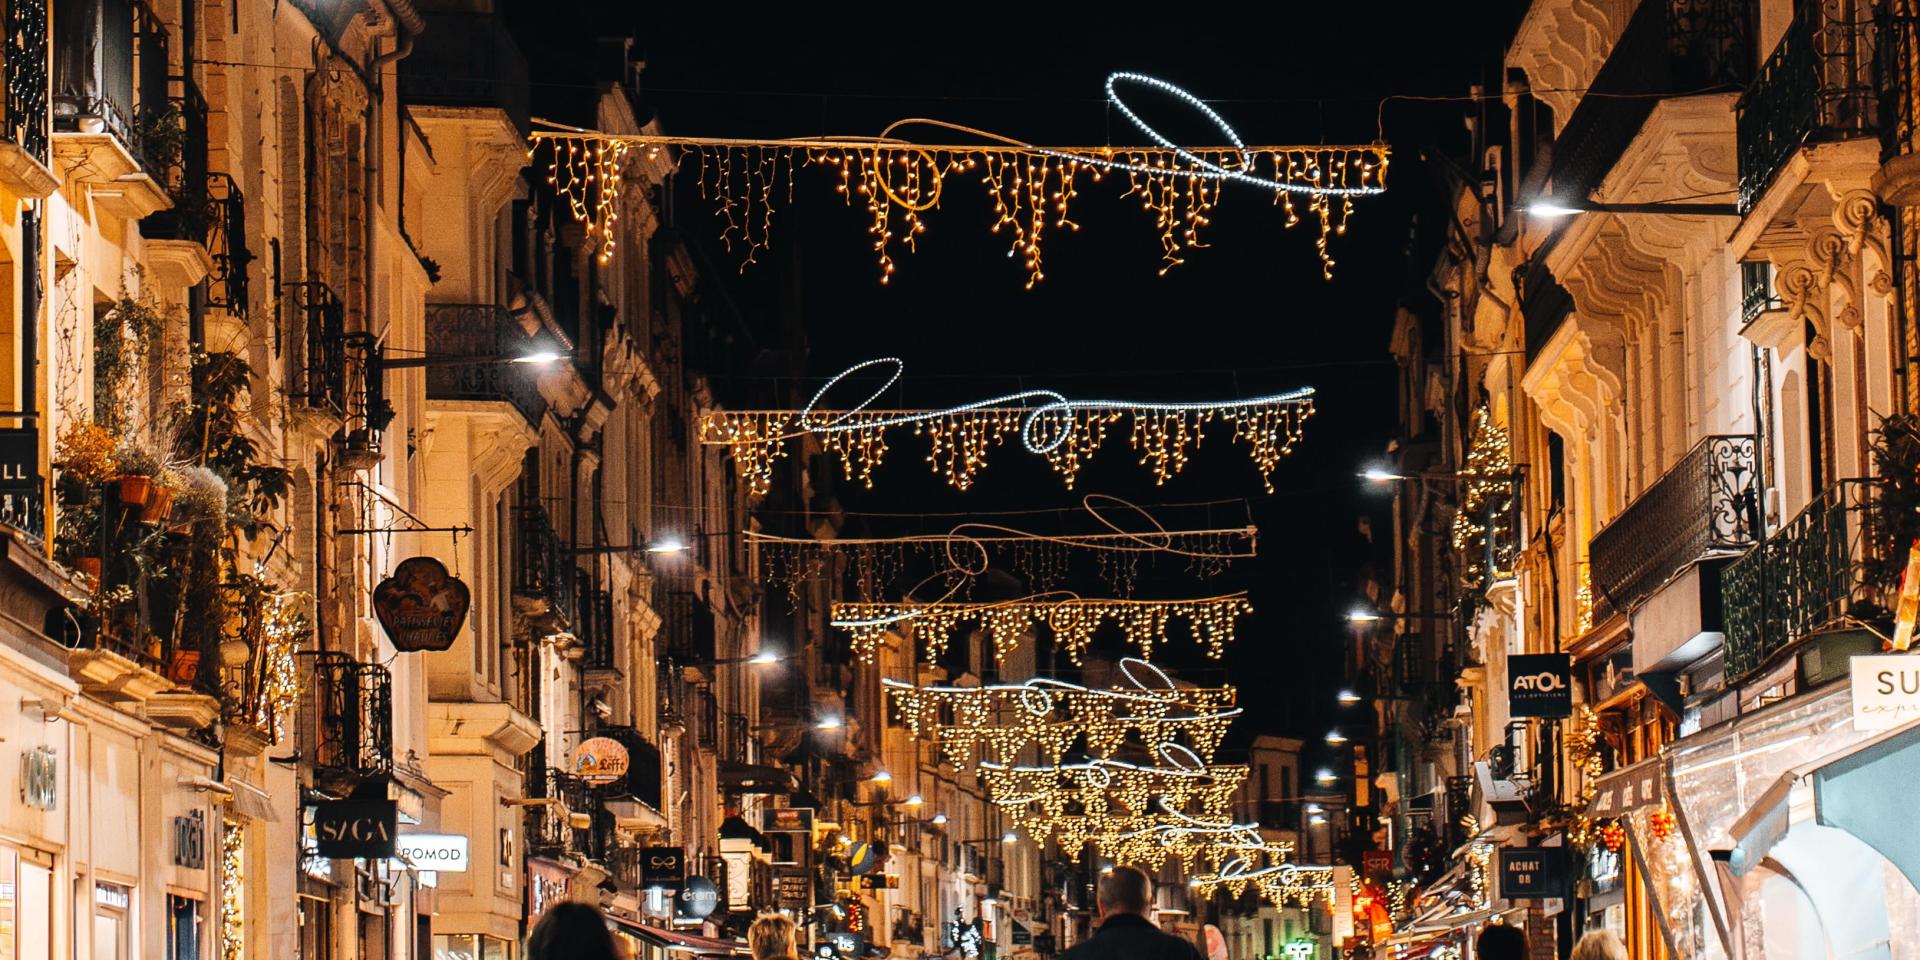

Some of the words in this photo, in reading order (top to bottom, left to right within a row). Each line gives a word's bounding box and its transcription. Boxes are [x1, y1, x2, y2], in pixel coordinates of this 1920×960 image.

[1513, 671, 1566, 692] ATOL
[599, 758, 625, 772] Leffe
[322, 818, 388, 841] SAGA
[1509, 861, 1540, 871] ACHAT
